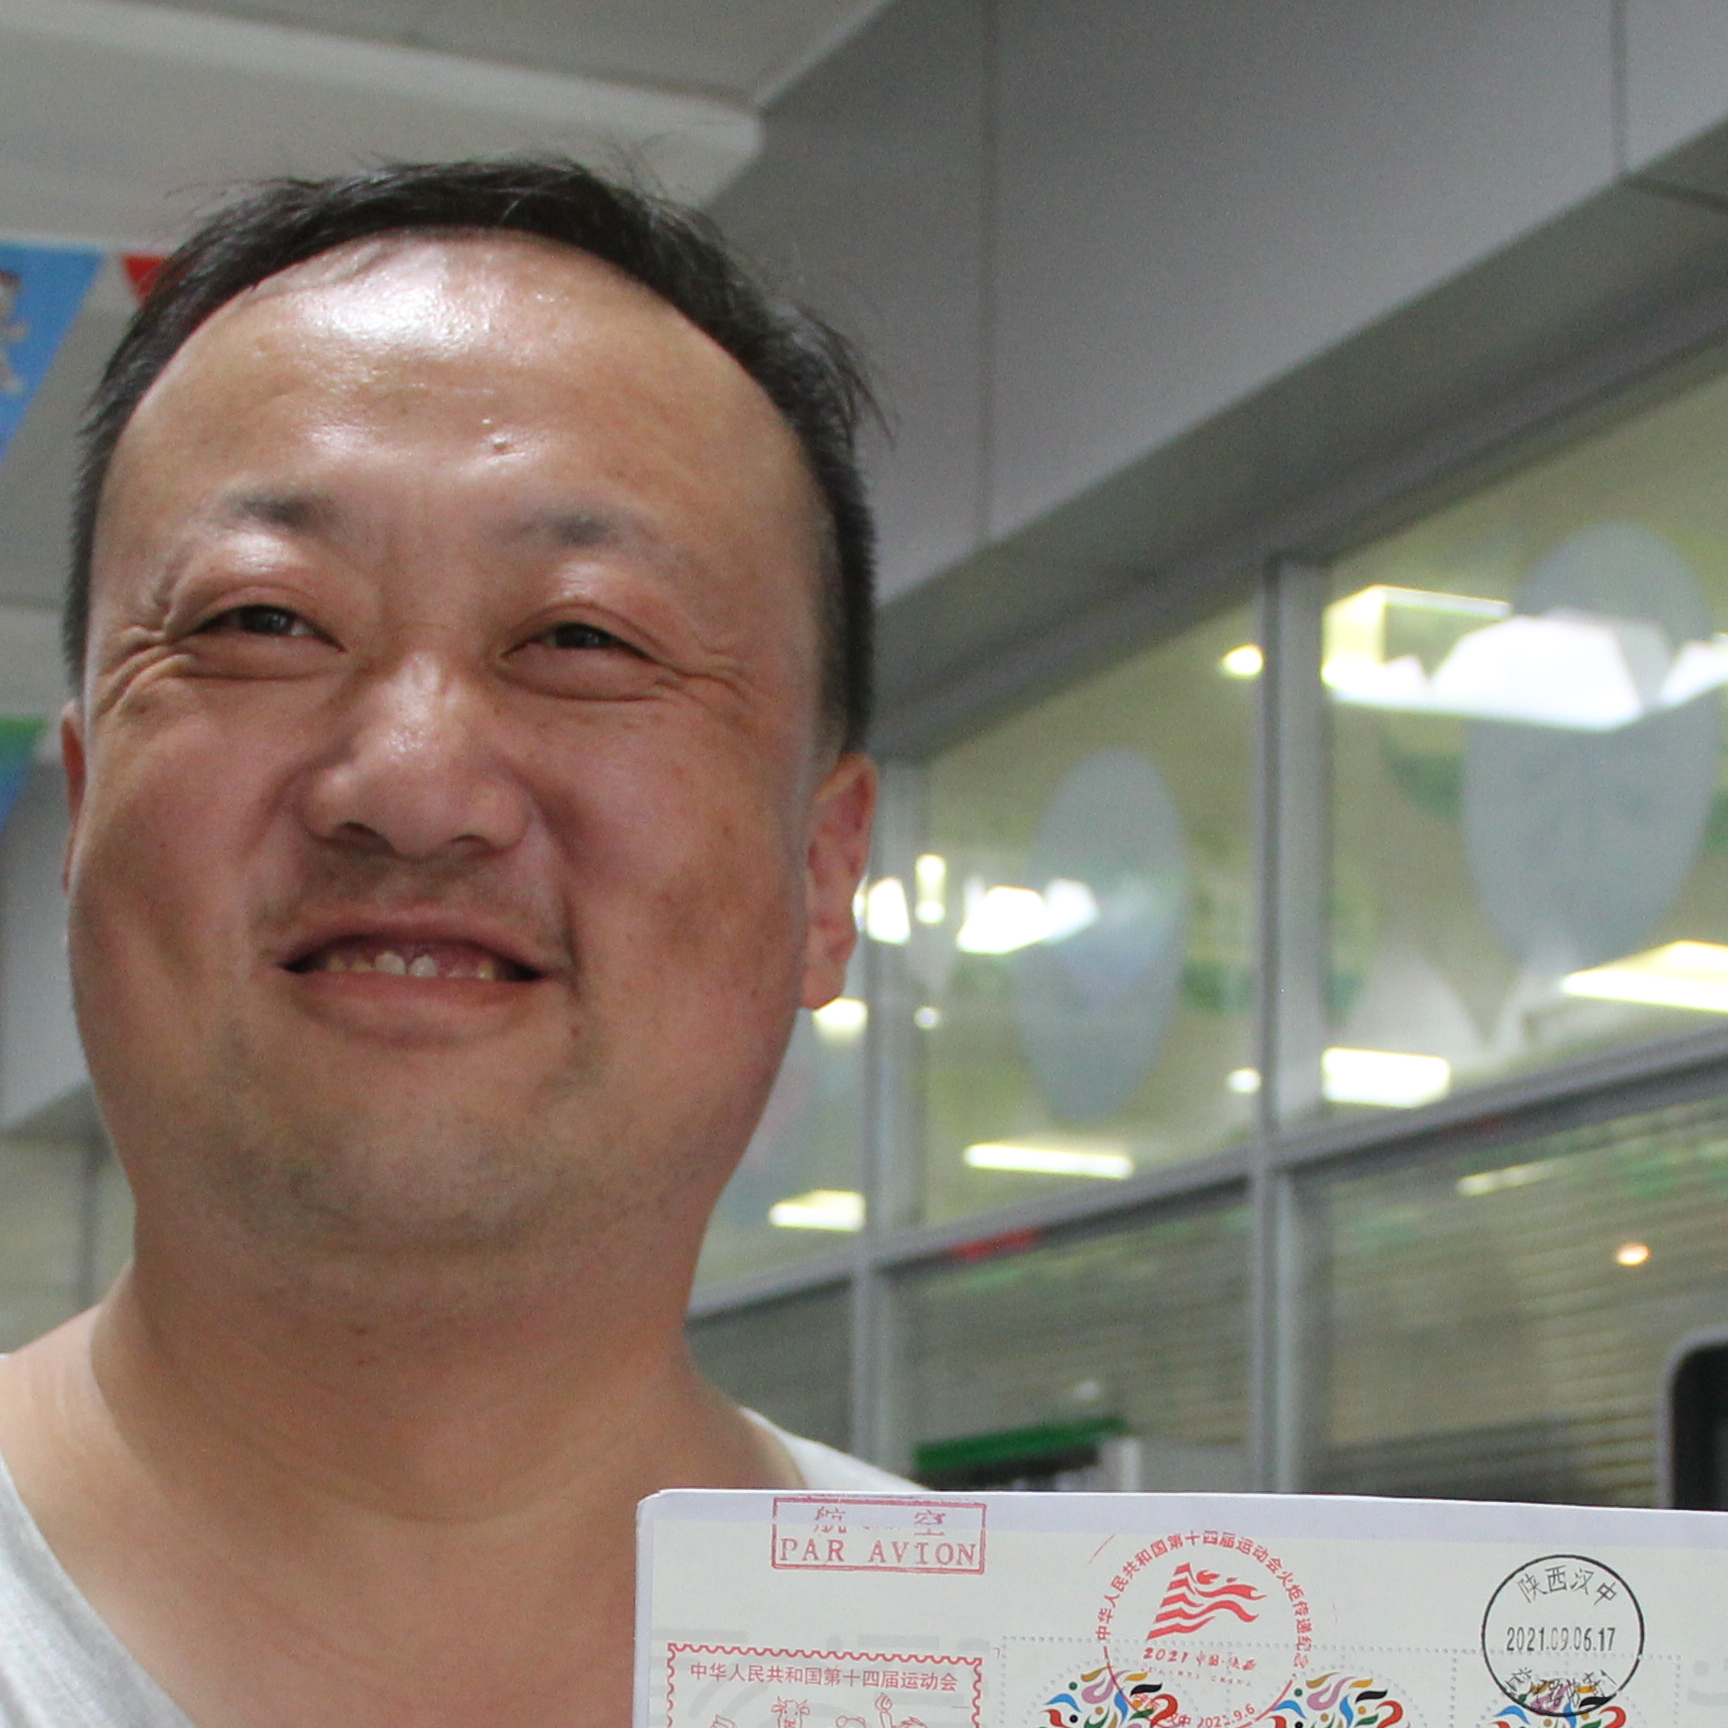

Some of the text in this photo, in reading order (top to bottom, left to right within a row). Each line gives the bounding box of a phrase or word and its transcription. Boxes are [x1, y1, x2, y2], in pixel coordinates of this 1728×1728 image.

[780, 1538, 976, 1566] PAR AVION
[1516, 1565, 1618, 1606] 陕西汉中
[690, 1662, 958, 1692] 中华人民共和国第十四届运动会
